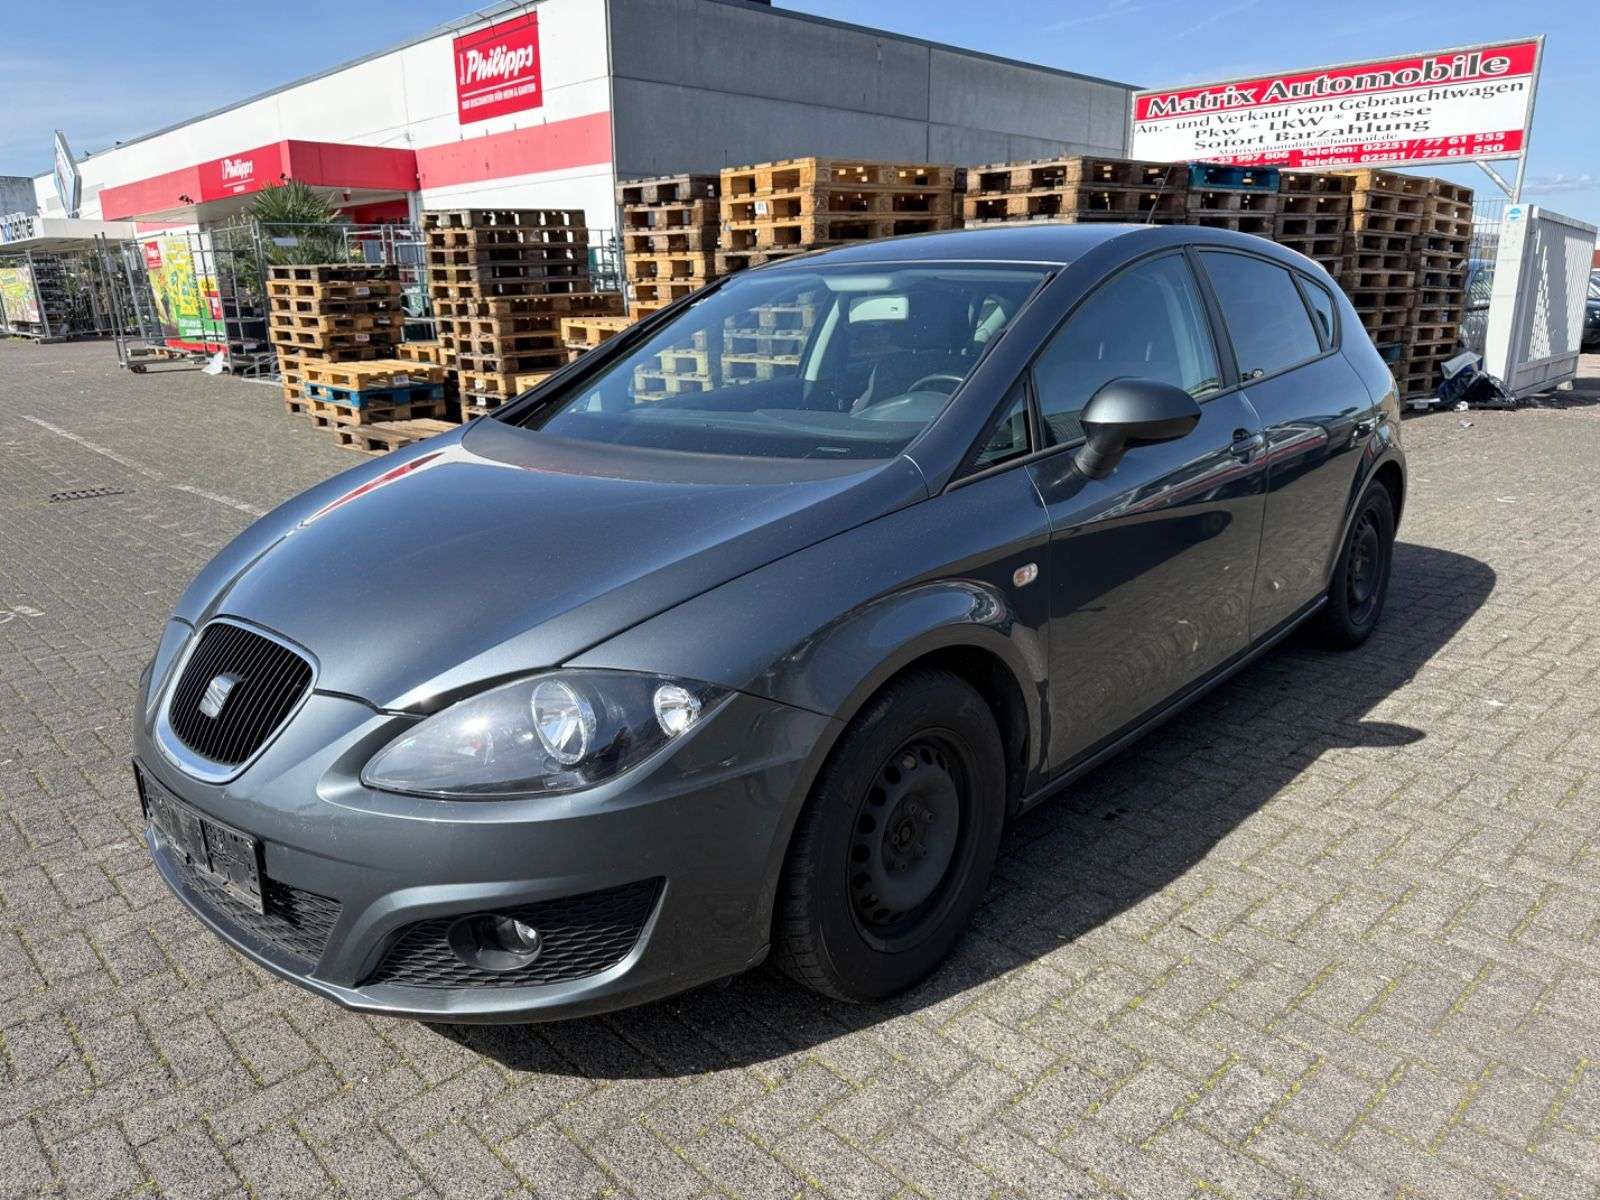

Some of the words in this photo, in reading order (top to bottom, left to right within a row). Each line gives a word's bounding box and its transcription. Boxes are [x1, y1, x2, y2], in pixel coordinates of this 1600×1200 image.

[466, 44, 534, 84] Philipps
[1146, 86, 1258, 118] Matrix
[1260, 52, 1511, 103] Automobile
[1176, 116, 1211, 130] und
[1217, 107, 1292, 124] Verkauf
[1297, 103, 1334, 115] von
[1339, 82, 1524, 111] Gebrauchtwagen
[1355, 107, 1432, 121] Busse
[1194, 135, 1265, 151] Sofort
[1275, 120, 1431, 142] Barzahlung
[1362, 139, 1408, 151] 02251
